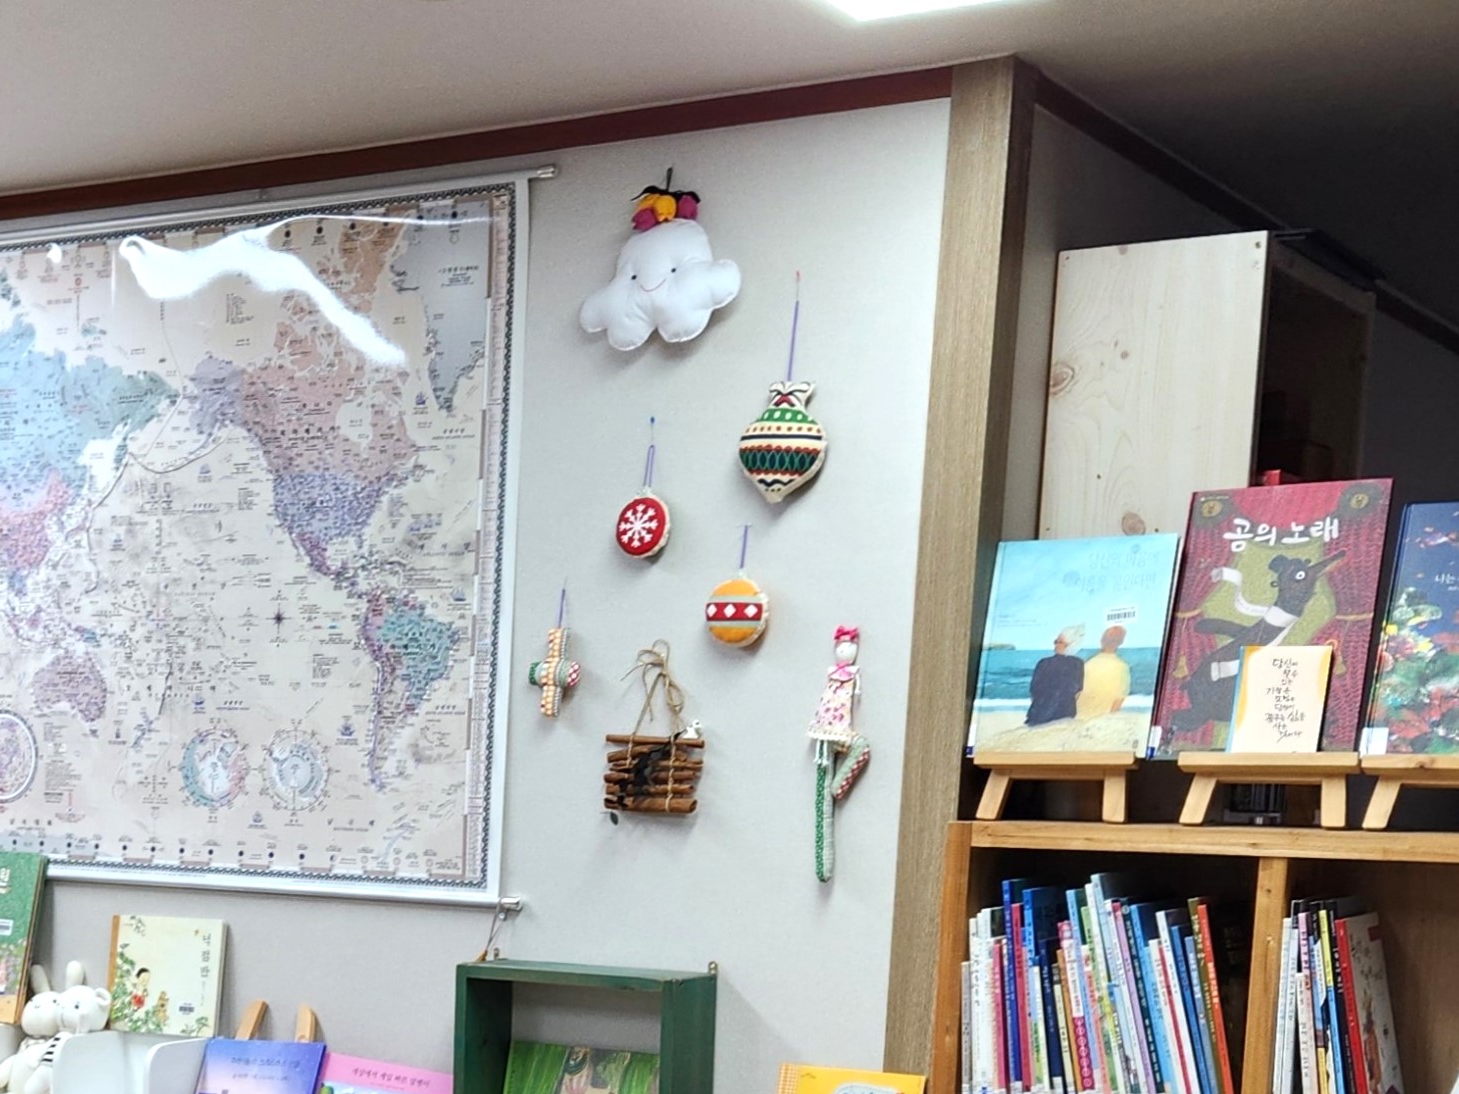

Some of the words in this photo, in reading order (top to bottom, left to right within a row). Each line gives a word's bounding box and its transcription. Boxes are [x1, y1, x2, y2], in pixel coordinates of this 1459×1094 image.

[1223, 518, 1277, 552] 곰의
[1281, 516, 1339, 544] 노래
[1435, 573, 1456, 585] 나는
